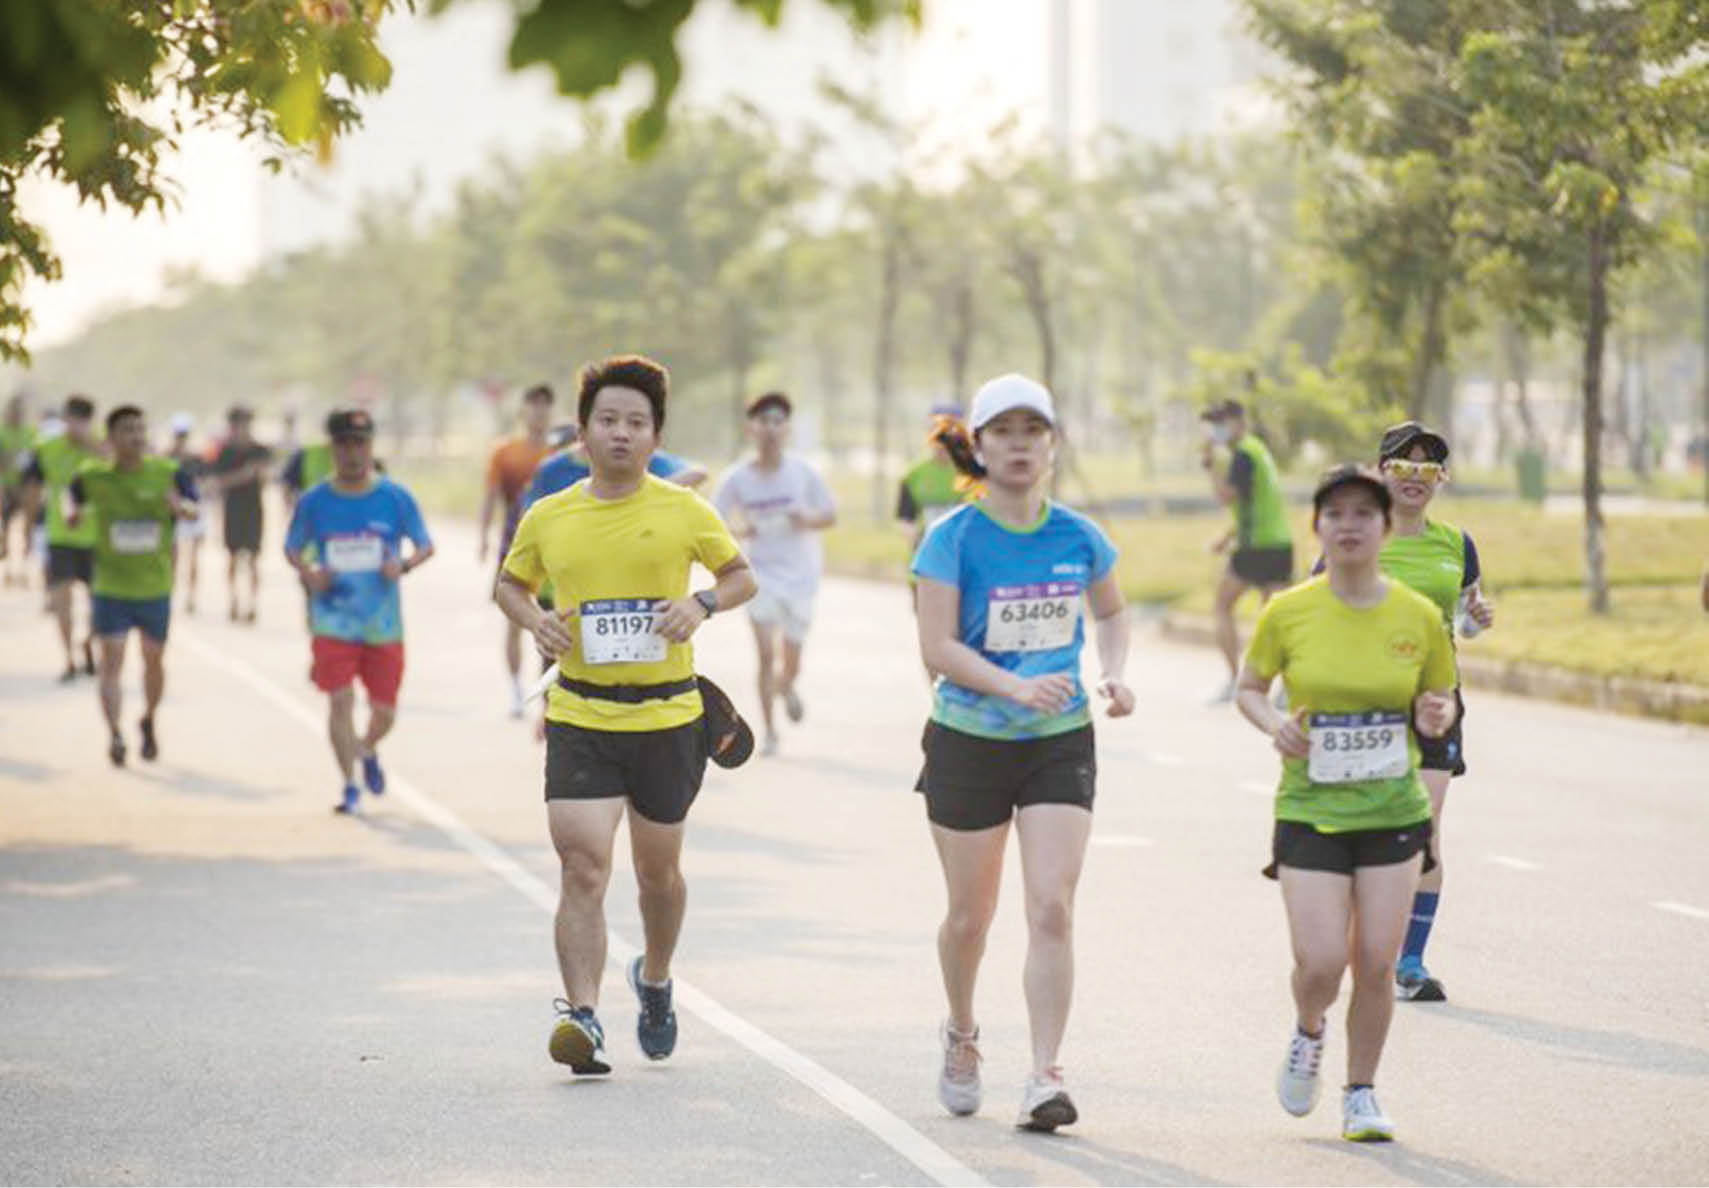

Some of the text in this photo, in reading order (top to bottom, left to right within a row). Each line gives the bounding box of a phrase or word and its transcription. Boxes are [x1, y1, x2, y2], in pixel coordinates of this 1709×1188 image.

[1001, 601, 1069, 623] 63406
[596, 616, 654, 635] 81197
[1323, 729, 1393, 751] 83559
